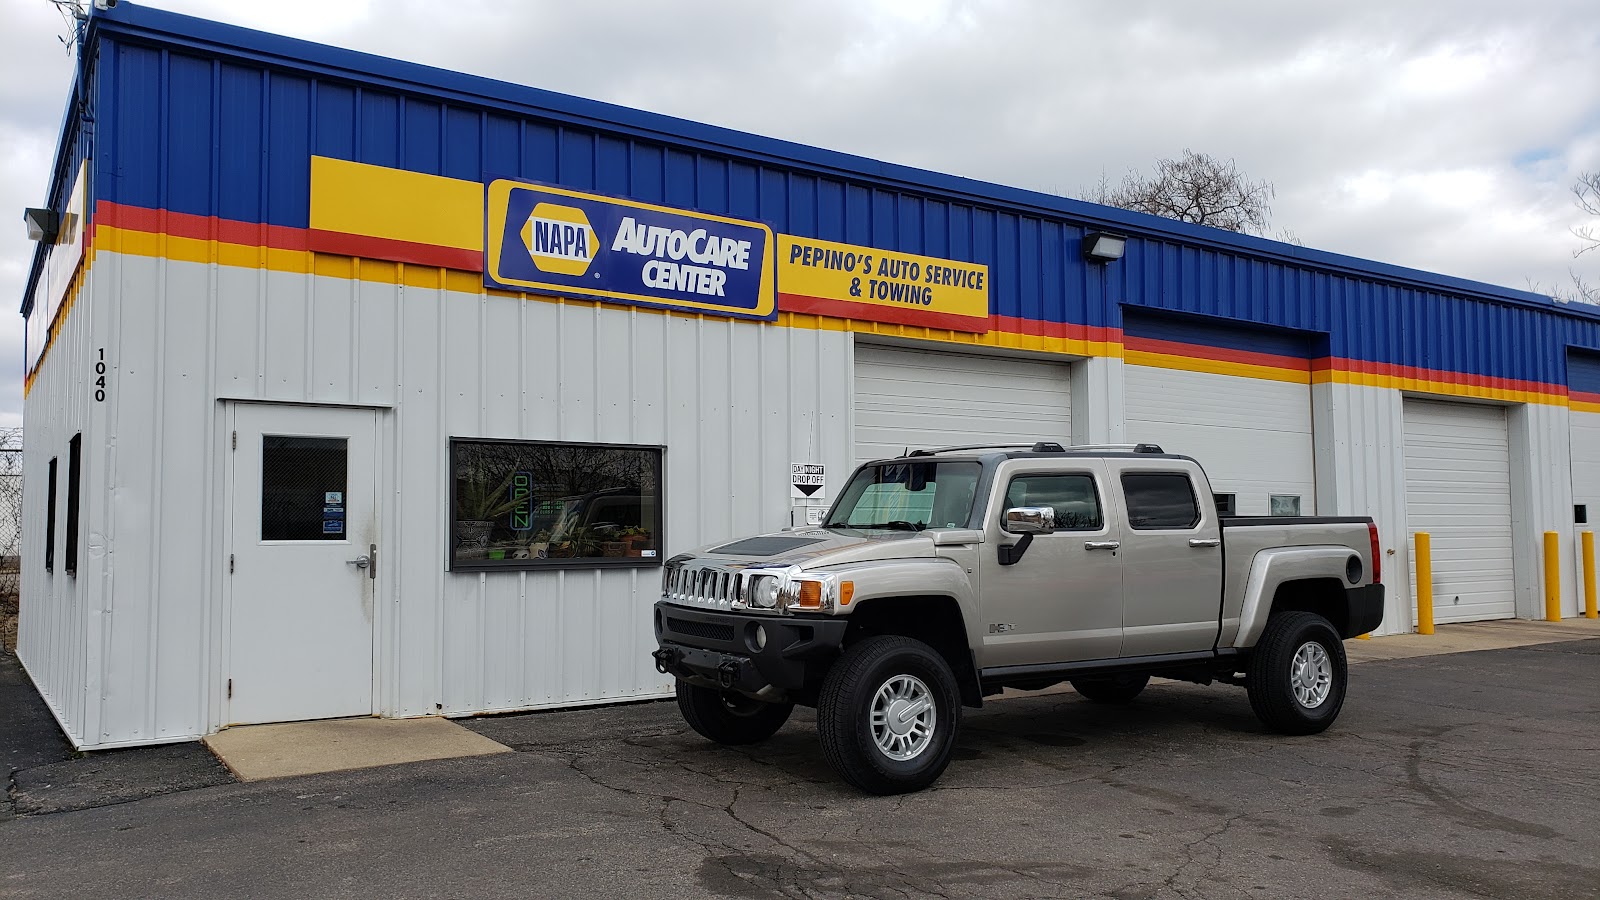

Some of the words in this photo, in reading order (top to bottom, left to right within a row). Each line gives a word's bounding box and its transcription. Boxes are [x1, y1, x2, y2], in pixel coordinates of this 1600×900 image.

[535, 220, 588, 258] NAPA
[641, 259, 727, 297] CENTER
[790, 243, 873, 275] PEPINO'S
[877, 260, 921, 281] AUTO
[925, 264, 985, 291] SERVICE
[849, 277, 863, 297] &
[868, 279, 933, 307] TOWING
[95, 347, 106, 402] 1040
[792, 475, 811, 484] DROP
[811, 475, 824, 484] OFF
[805, 465, 824, 474] NIGHT
[514, 475, 529, 528] OPEN
